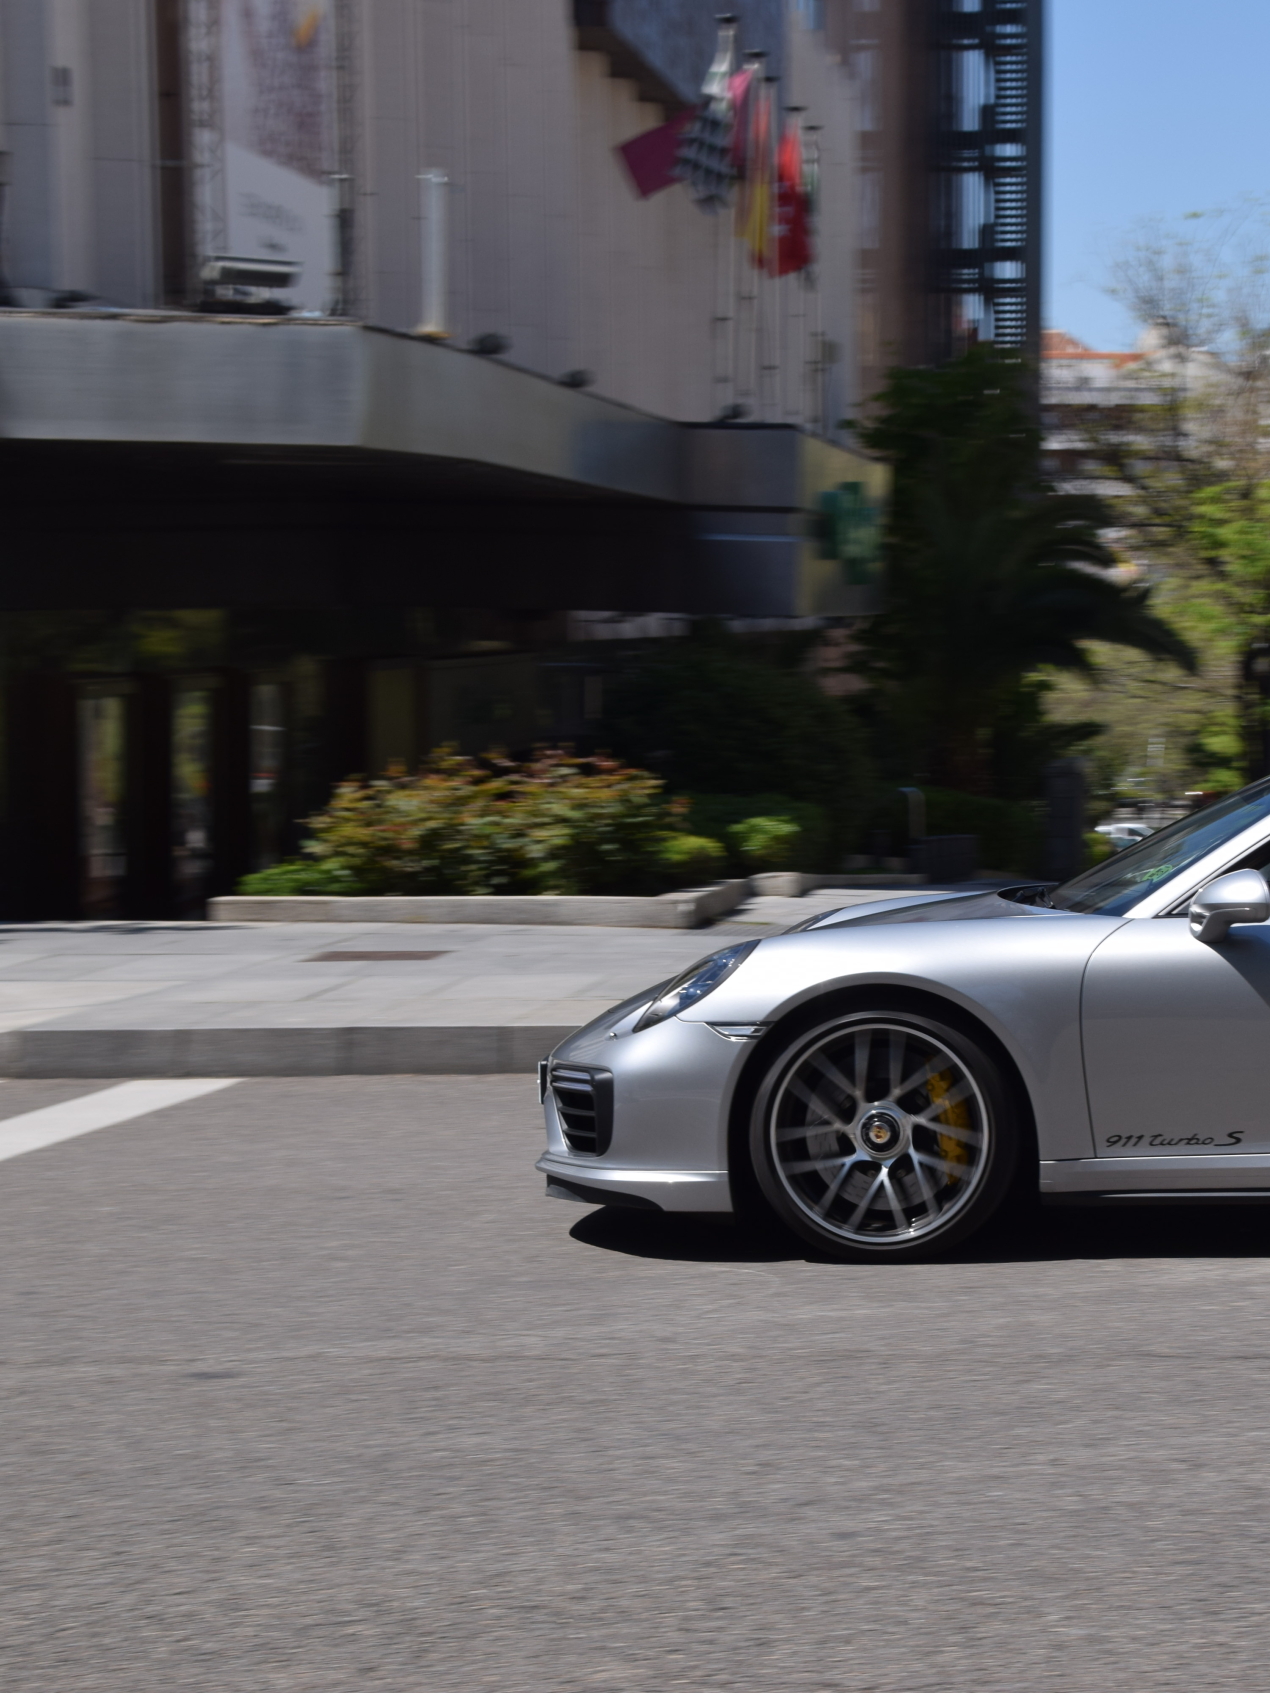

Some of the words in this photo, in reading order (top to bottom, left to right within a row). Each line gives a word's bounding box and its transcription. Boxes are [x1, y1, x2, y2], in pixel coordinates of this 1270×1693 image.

[1105, 1134, 1145, 1148] 911
[1148, 1133, 1215, 1147] turbo
[1213, 1130, 1246, 1147] S
